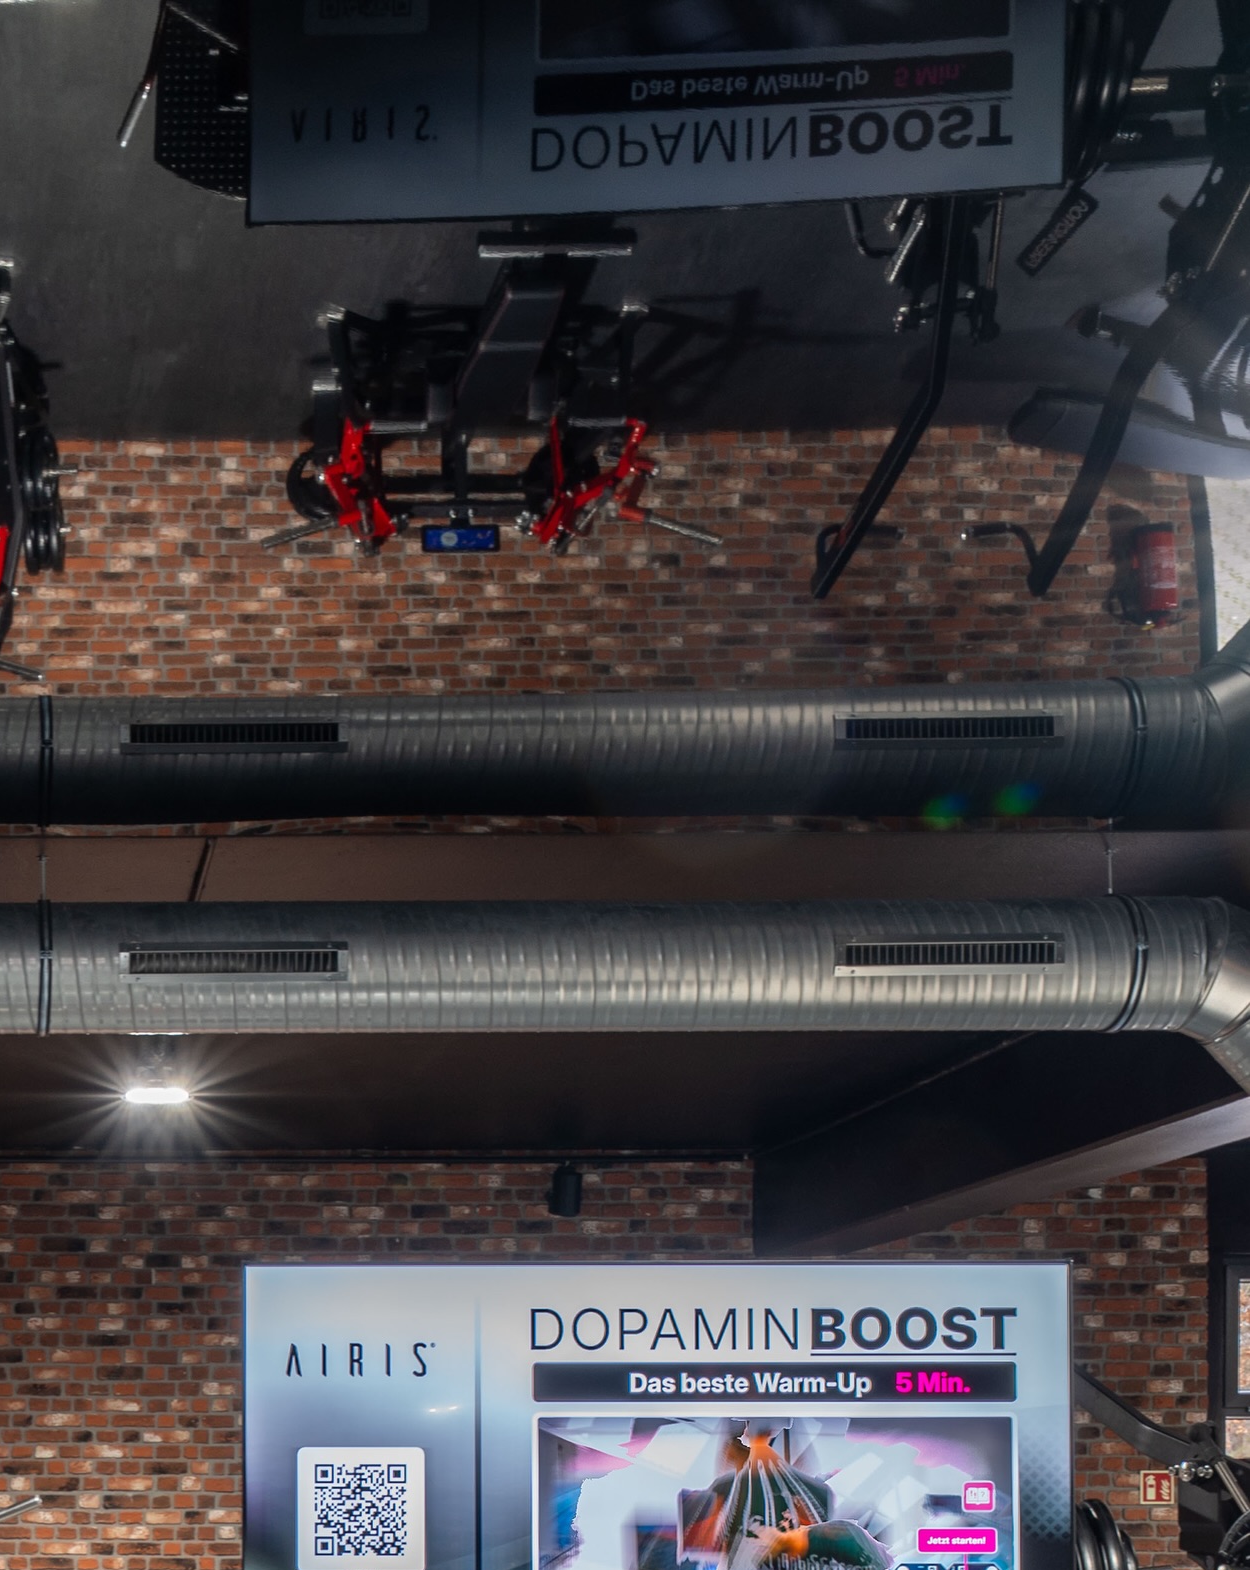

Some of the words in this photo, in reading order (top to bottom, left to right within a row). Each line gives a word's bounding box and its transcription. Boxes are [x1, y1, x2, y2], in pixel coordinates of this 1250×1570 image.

[629, 1371, 677, 1393] Das
[680, 1371, 749, 1393] beste
[753, 1370, 872, 1396] Warm-Up
[895, 1371, 913, 1392] 5
[917, 1370, 971, 1393] Min.
[926, 1536, 950, 1545] Jetzt
[951, 1536, 986, 1545] starten!
